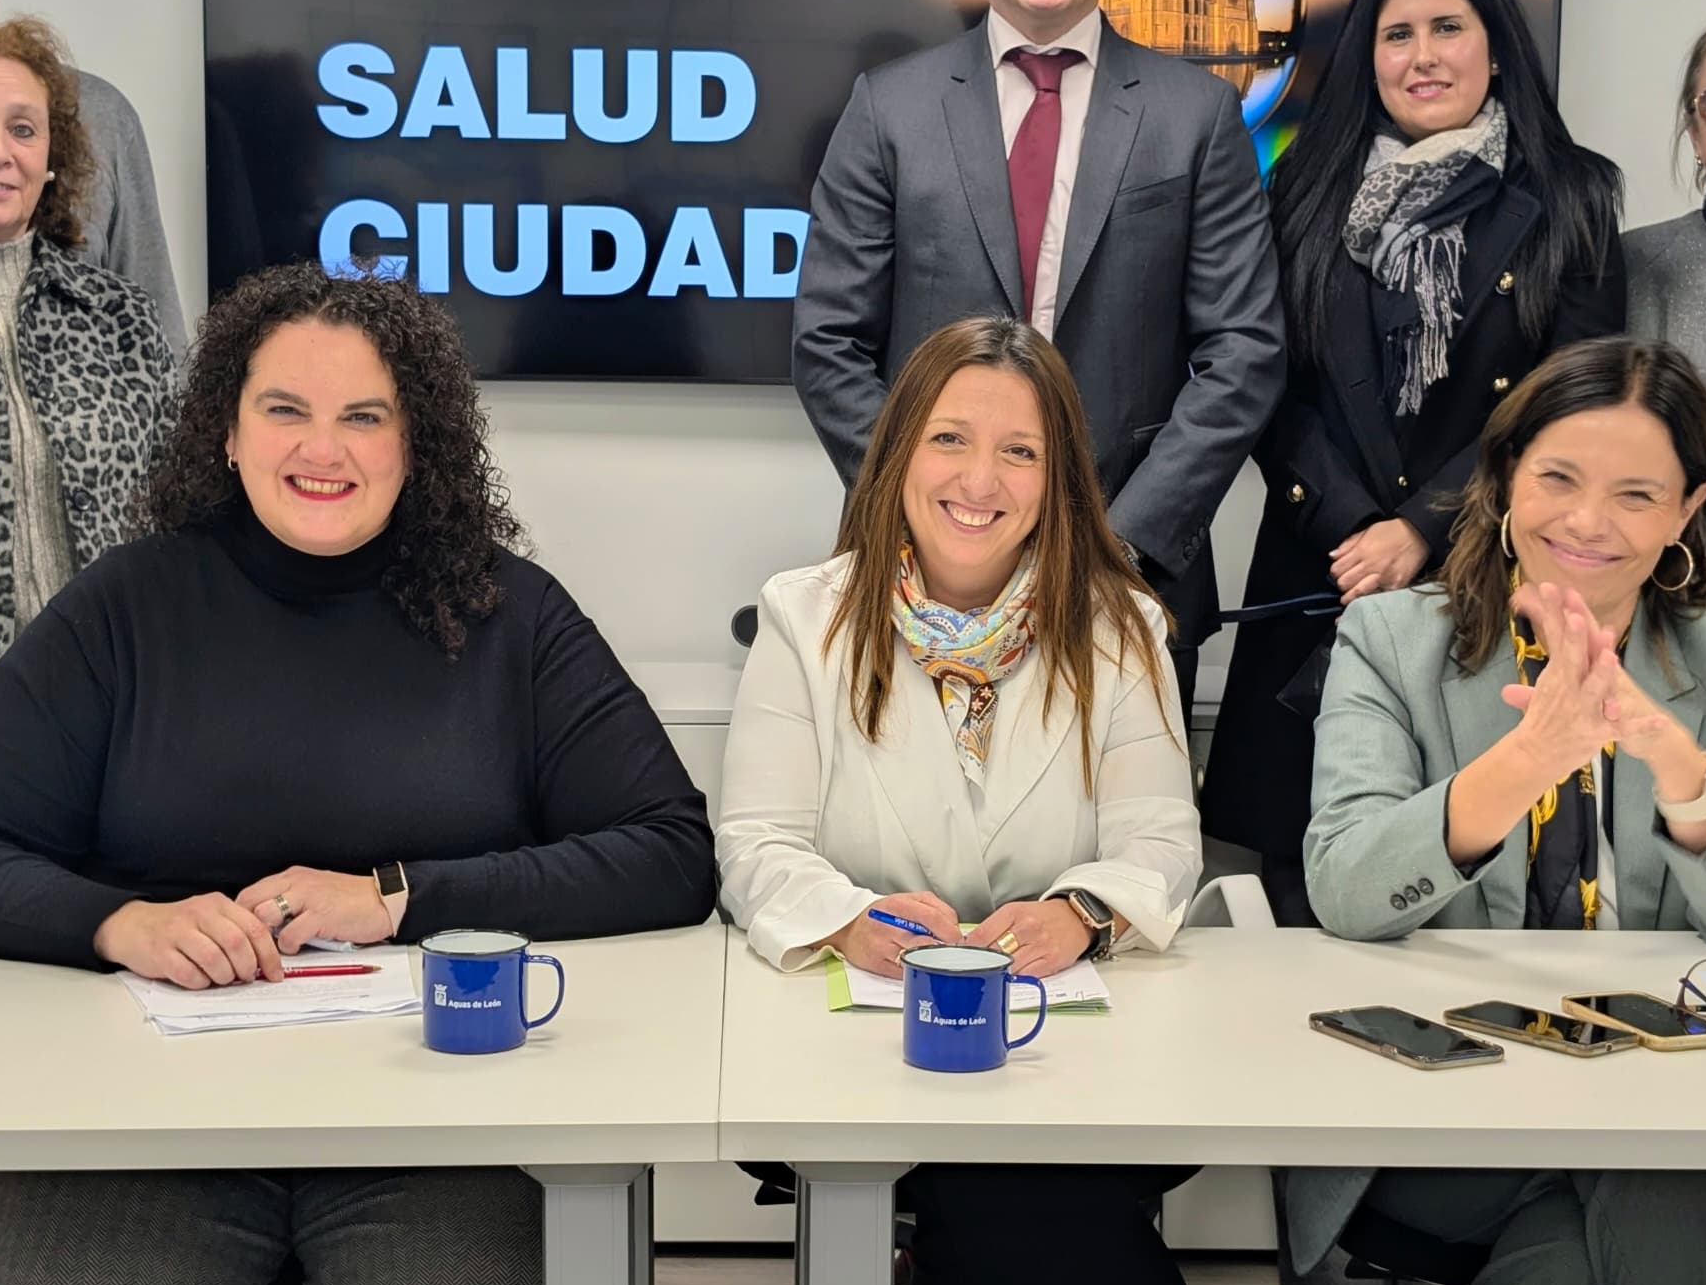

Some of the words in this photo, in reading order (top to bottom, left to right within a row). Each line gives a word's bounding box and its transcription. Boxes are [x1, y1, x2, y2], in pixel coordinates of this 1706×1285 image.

[316, 42, 757, 144] SALUD
[317, 198, 812, 300] CIUDAD
[448, 999, 471, 1009] Aguas
[472, 1000, 482, 1008] de
[483, 999, 502, 1008] León
[933, 1016, 957, 1027] Aguas
[958, 1017, 967, 1025] de
[969, 1016, 987, 1025] León
